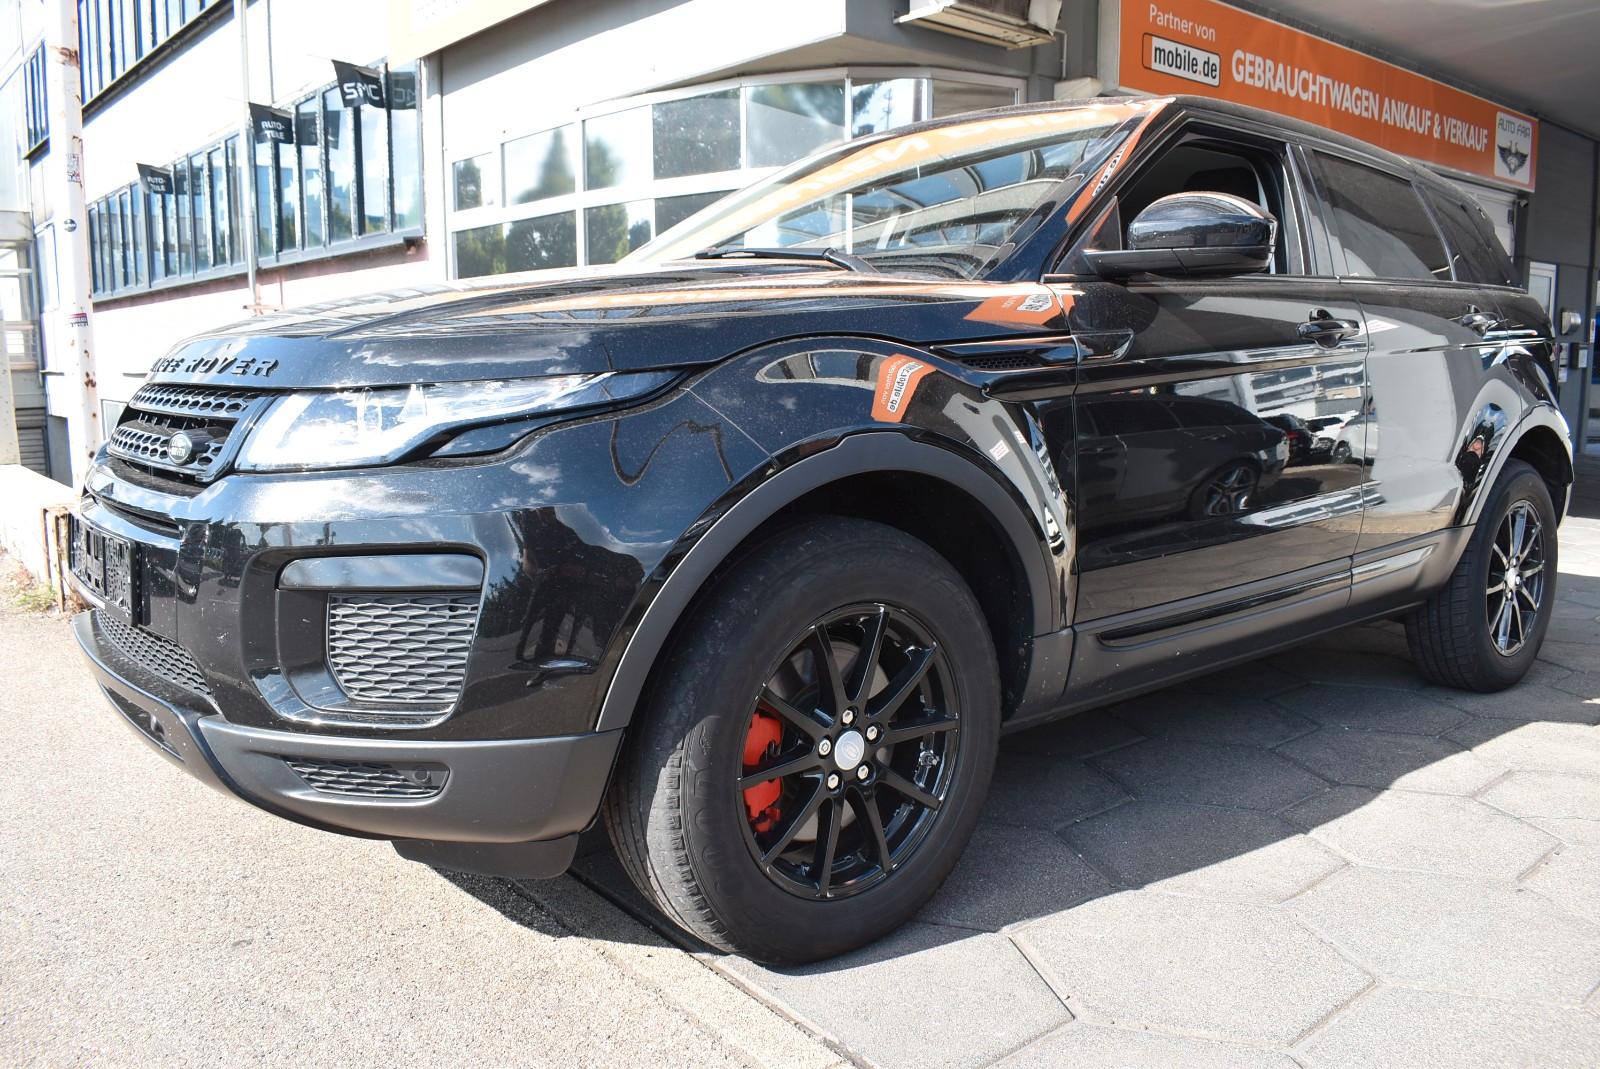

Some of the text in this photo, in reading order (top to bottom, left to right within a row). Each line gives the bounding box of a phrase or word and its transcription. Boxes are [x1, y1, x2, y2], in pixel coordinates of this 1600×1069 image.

[1150, 4, 1216, 42] Partner von
[1154, 46, 1218, 80] mobile.de
[343, 82, 380, 101] SMC
[1232, 49, 1488, 152] GEBRAUCHTWAGEN ANKAUF & VERKAUF
[261, 120, 286, 130] AUTO-
[265, 129, 285, 140] TEILE
[1498, 118, 1515, 134] AUTO
[185, 357, 280, 377] ROVER
